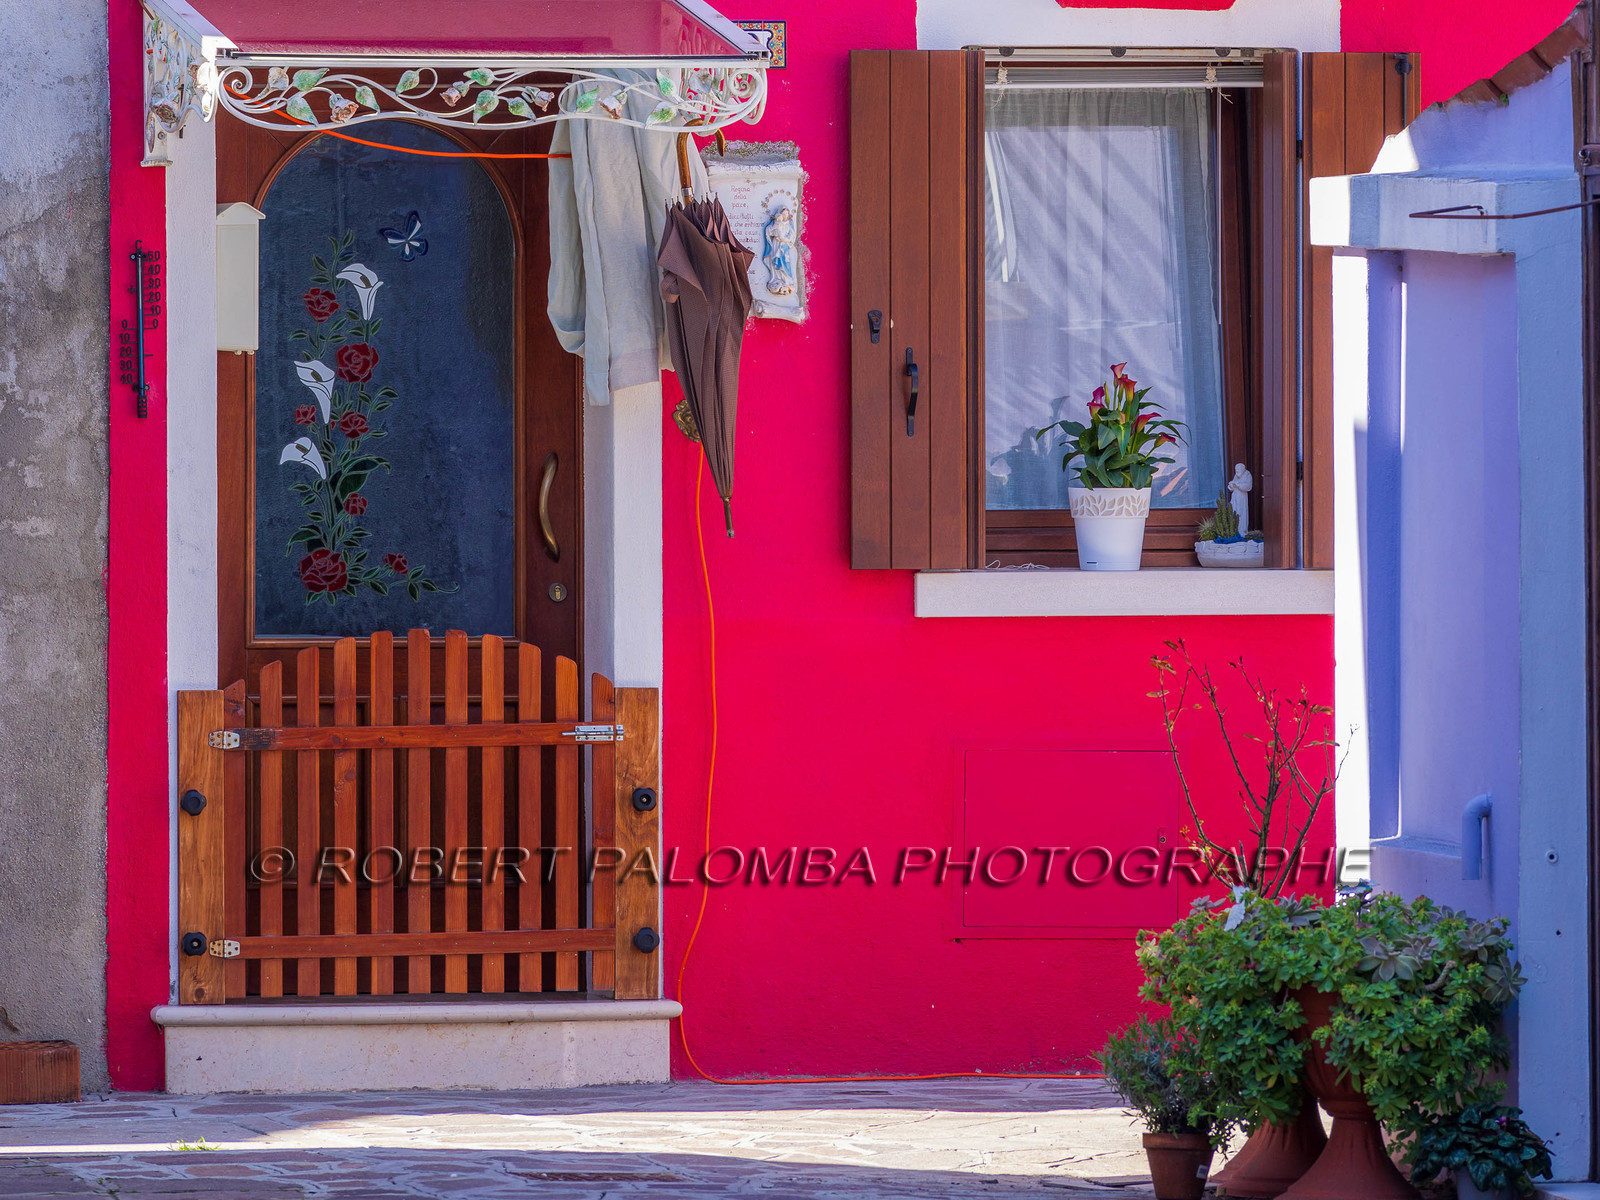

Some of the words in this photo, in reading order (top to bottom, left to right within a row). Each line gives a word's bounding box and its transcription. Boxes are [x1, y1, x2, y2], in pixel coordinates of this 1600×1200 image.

[730, 184, 751, 194] Regina
[147, 250, 161, 261] 50
[147, 263, 161, 275] 40
[149, 291, 162, 302] 20
[150, 304, 162, 316] 10
[121, 318, 128, 330] 0
[152, 318, 159, 329] 0
[119, 332, 131, 343] 10
[120, 346, 132, 357] 20
[120, 359, 133, 370] 30
[120, 372, 133, 383] 40
